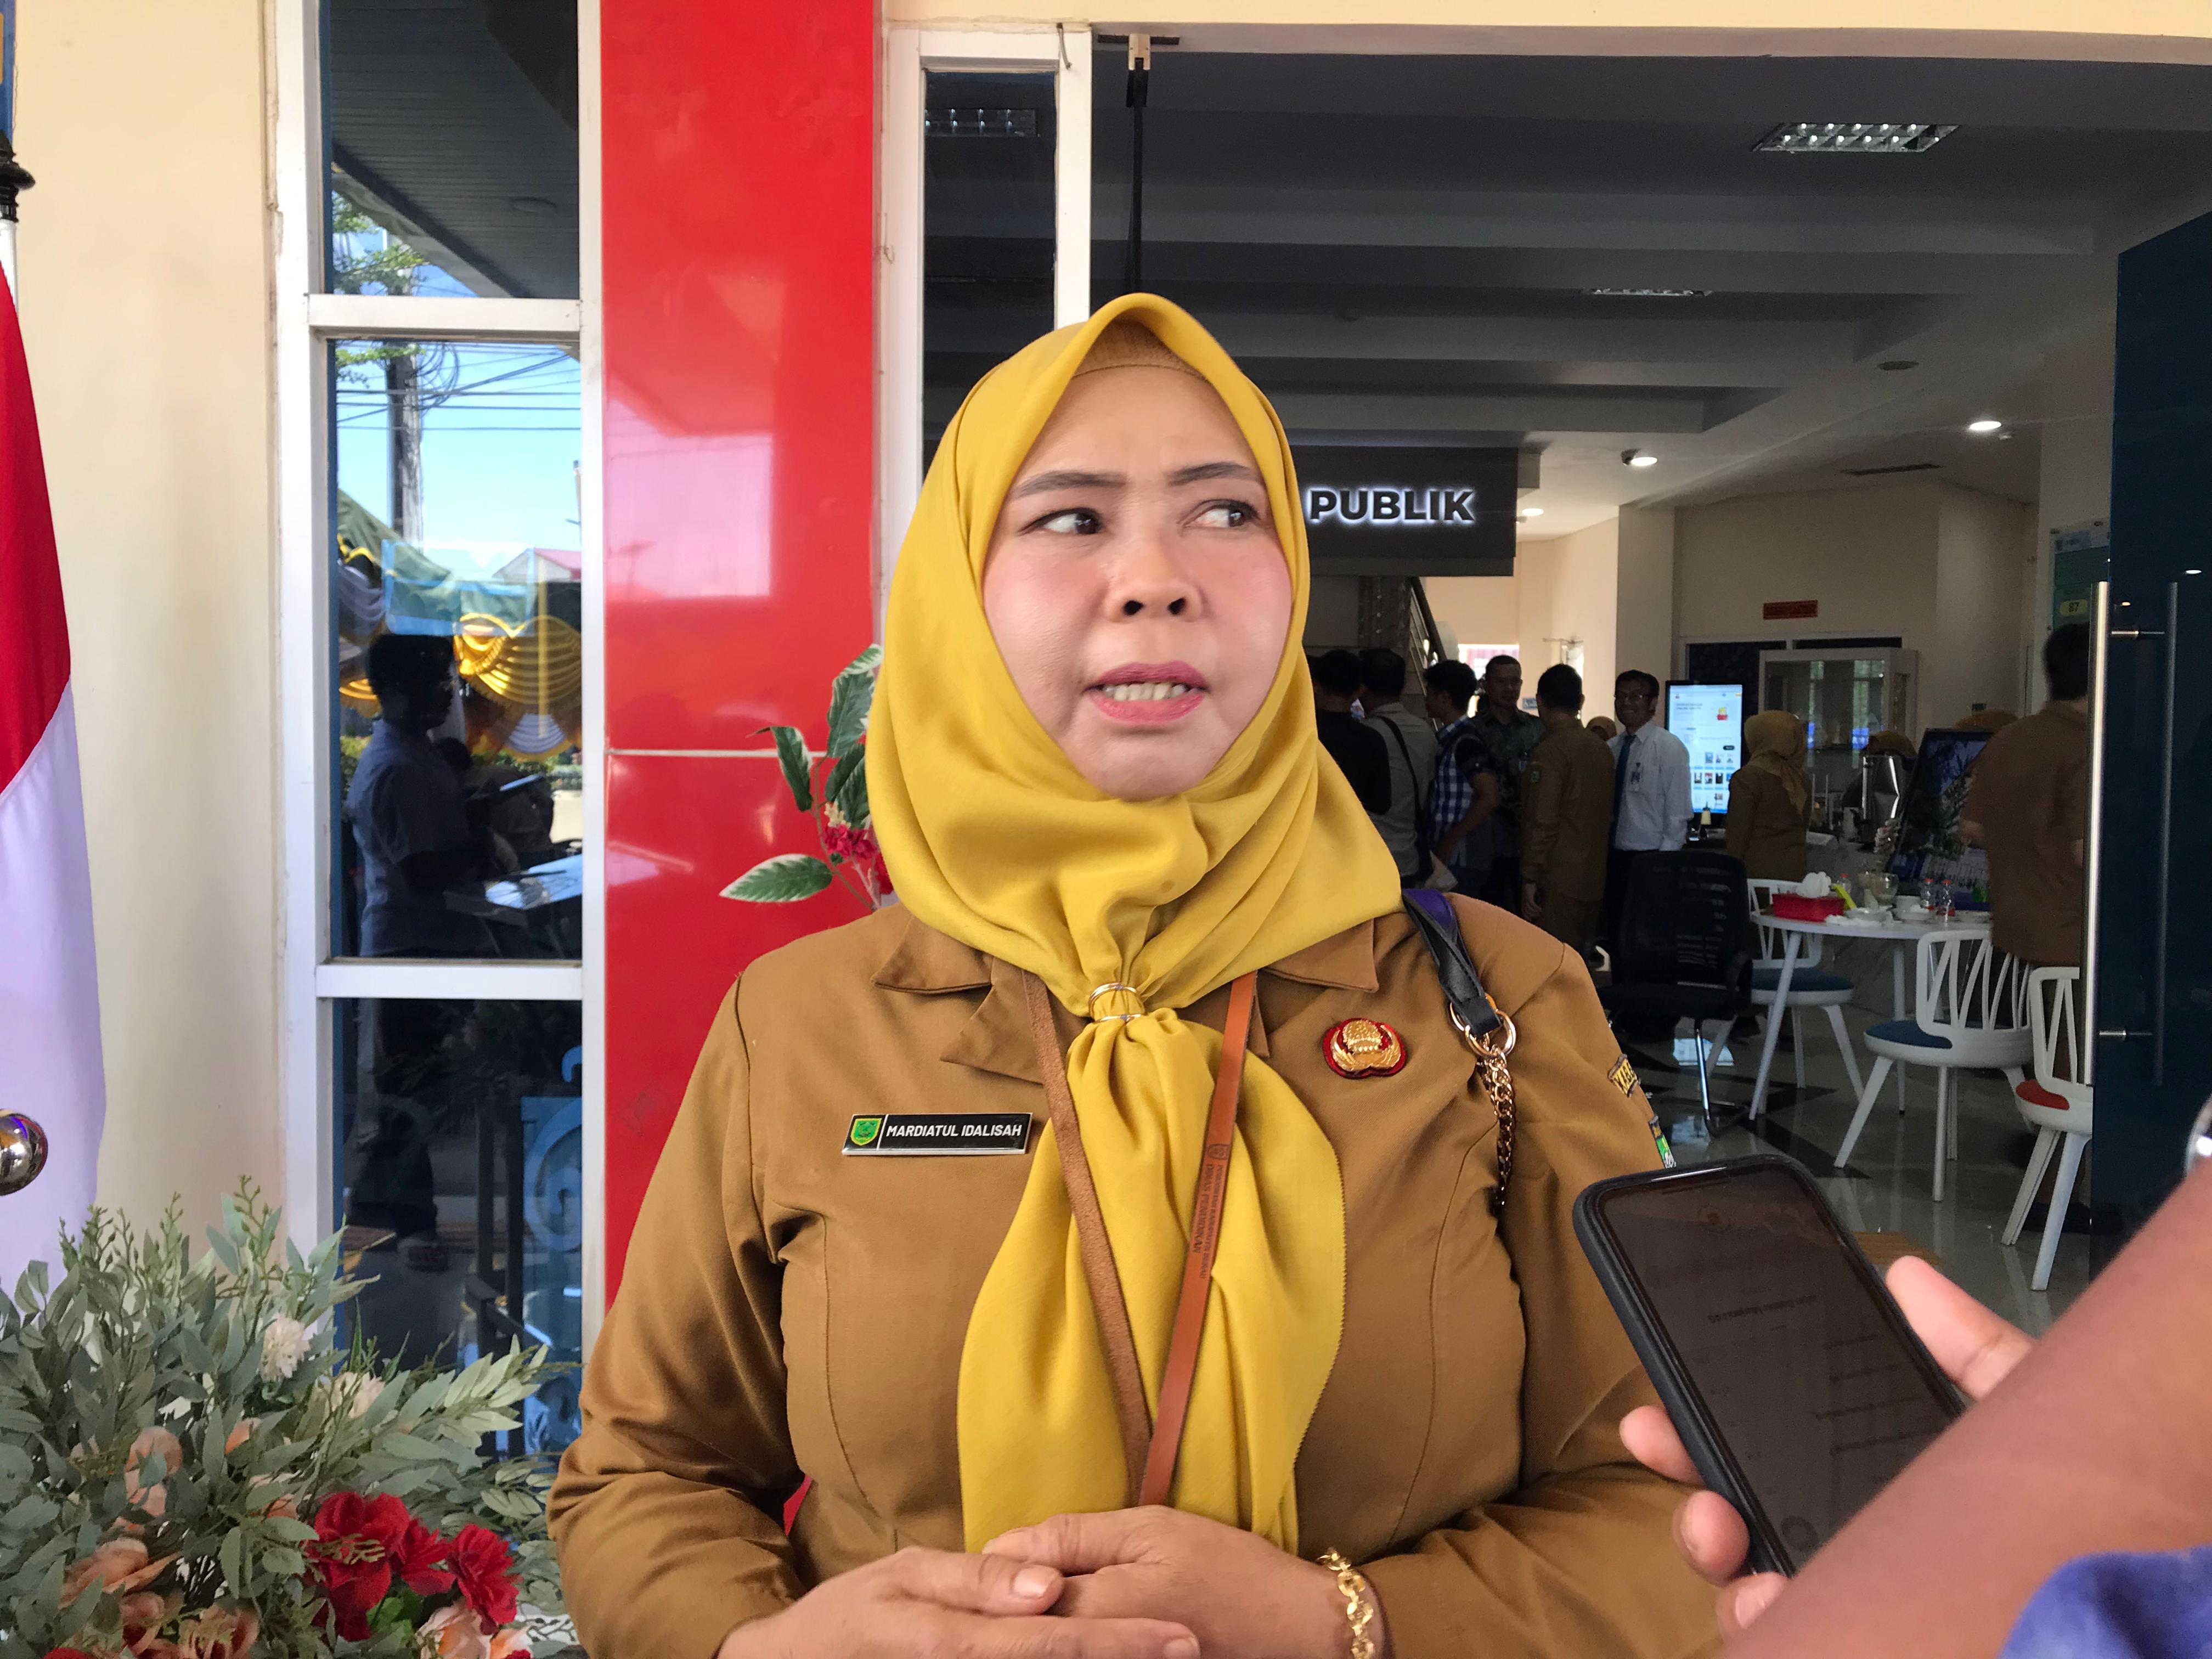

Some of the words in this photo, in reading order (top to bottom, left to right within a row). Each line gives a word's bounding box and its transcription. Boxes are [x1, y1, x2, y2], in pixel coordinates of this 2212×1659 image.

[1310, 489, 1475, 520] PUBLIK
[886, 1125, 958, 1137] MARDIATUL
[961, 1125, 1022, 1137] IDALISAH
